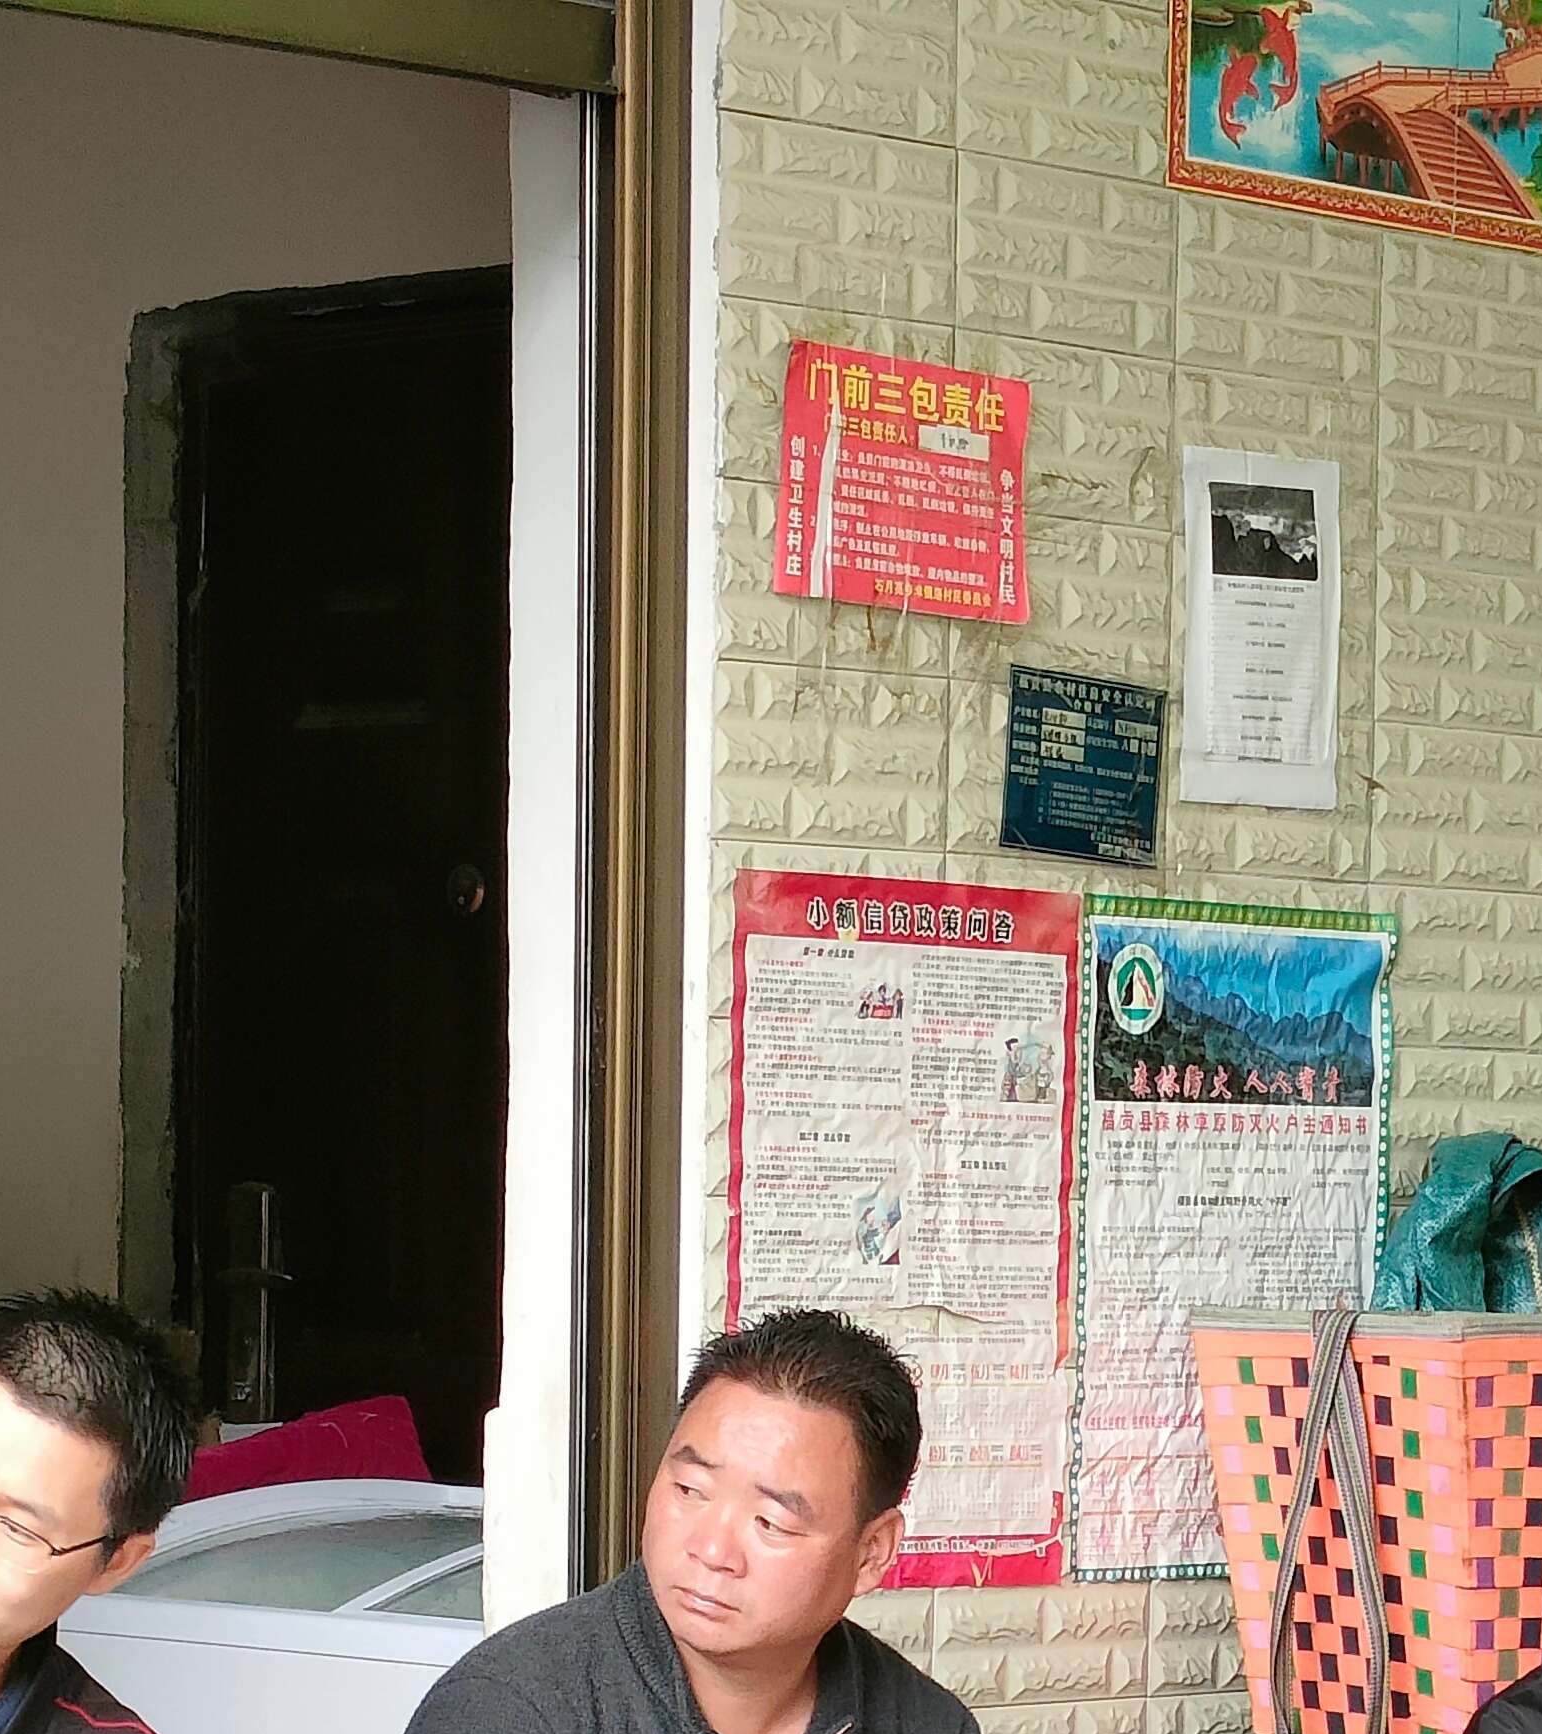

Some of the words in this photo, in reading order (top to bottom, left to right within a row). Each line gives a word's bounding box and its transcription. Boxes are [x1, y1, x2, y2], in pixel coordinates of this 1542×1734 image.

[809, 358, 1006, 432] 门前三包责任
[786, 435, 806, 576] 创建卫生村庄
[807, 897, 1015, 942] 小额信贷政策问答
[1130, 1060, 1233, 1102] 森林防火
